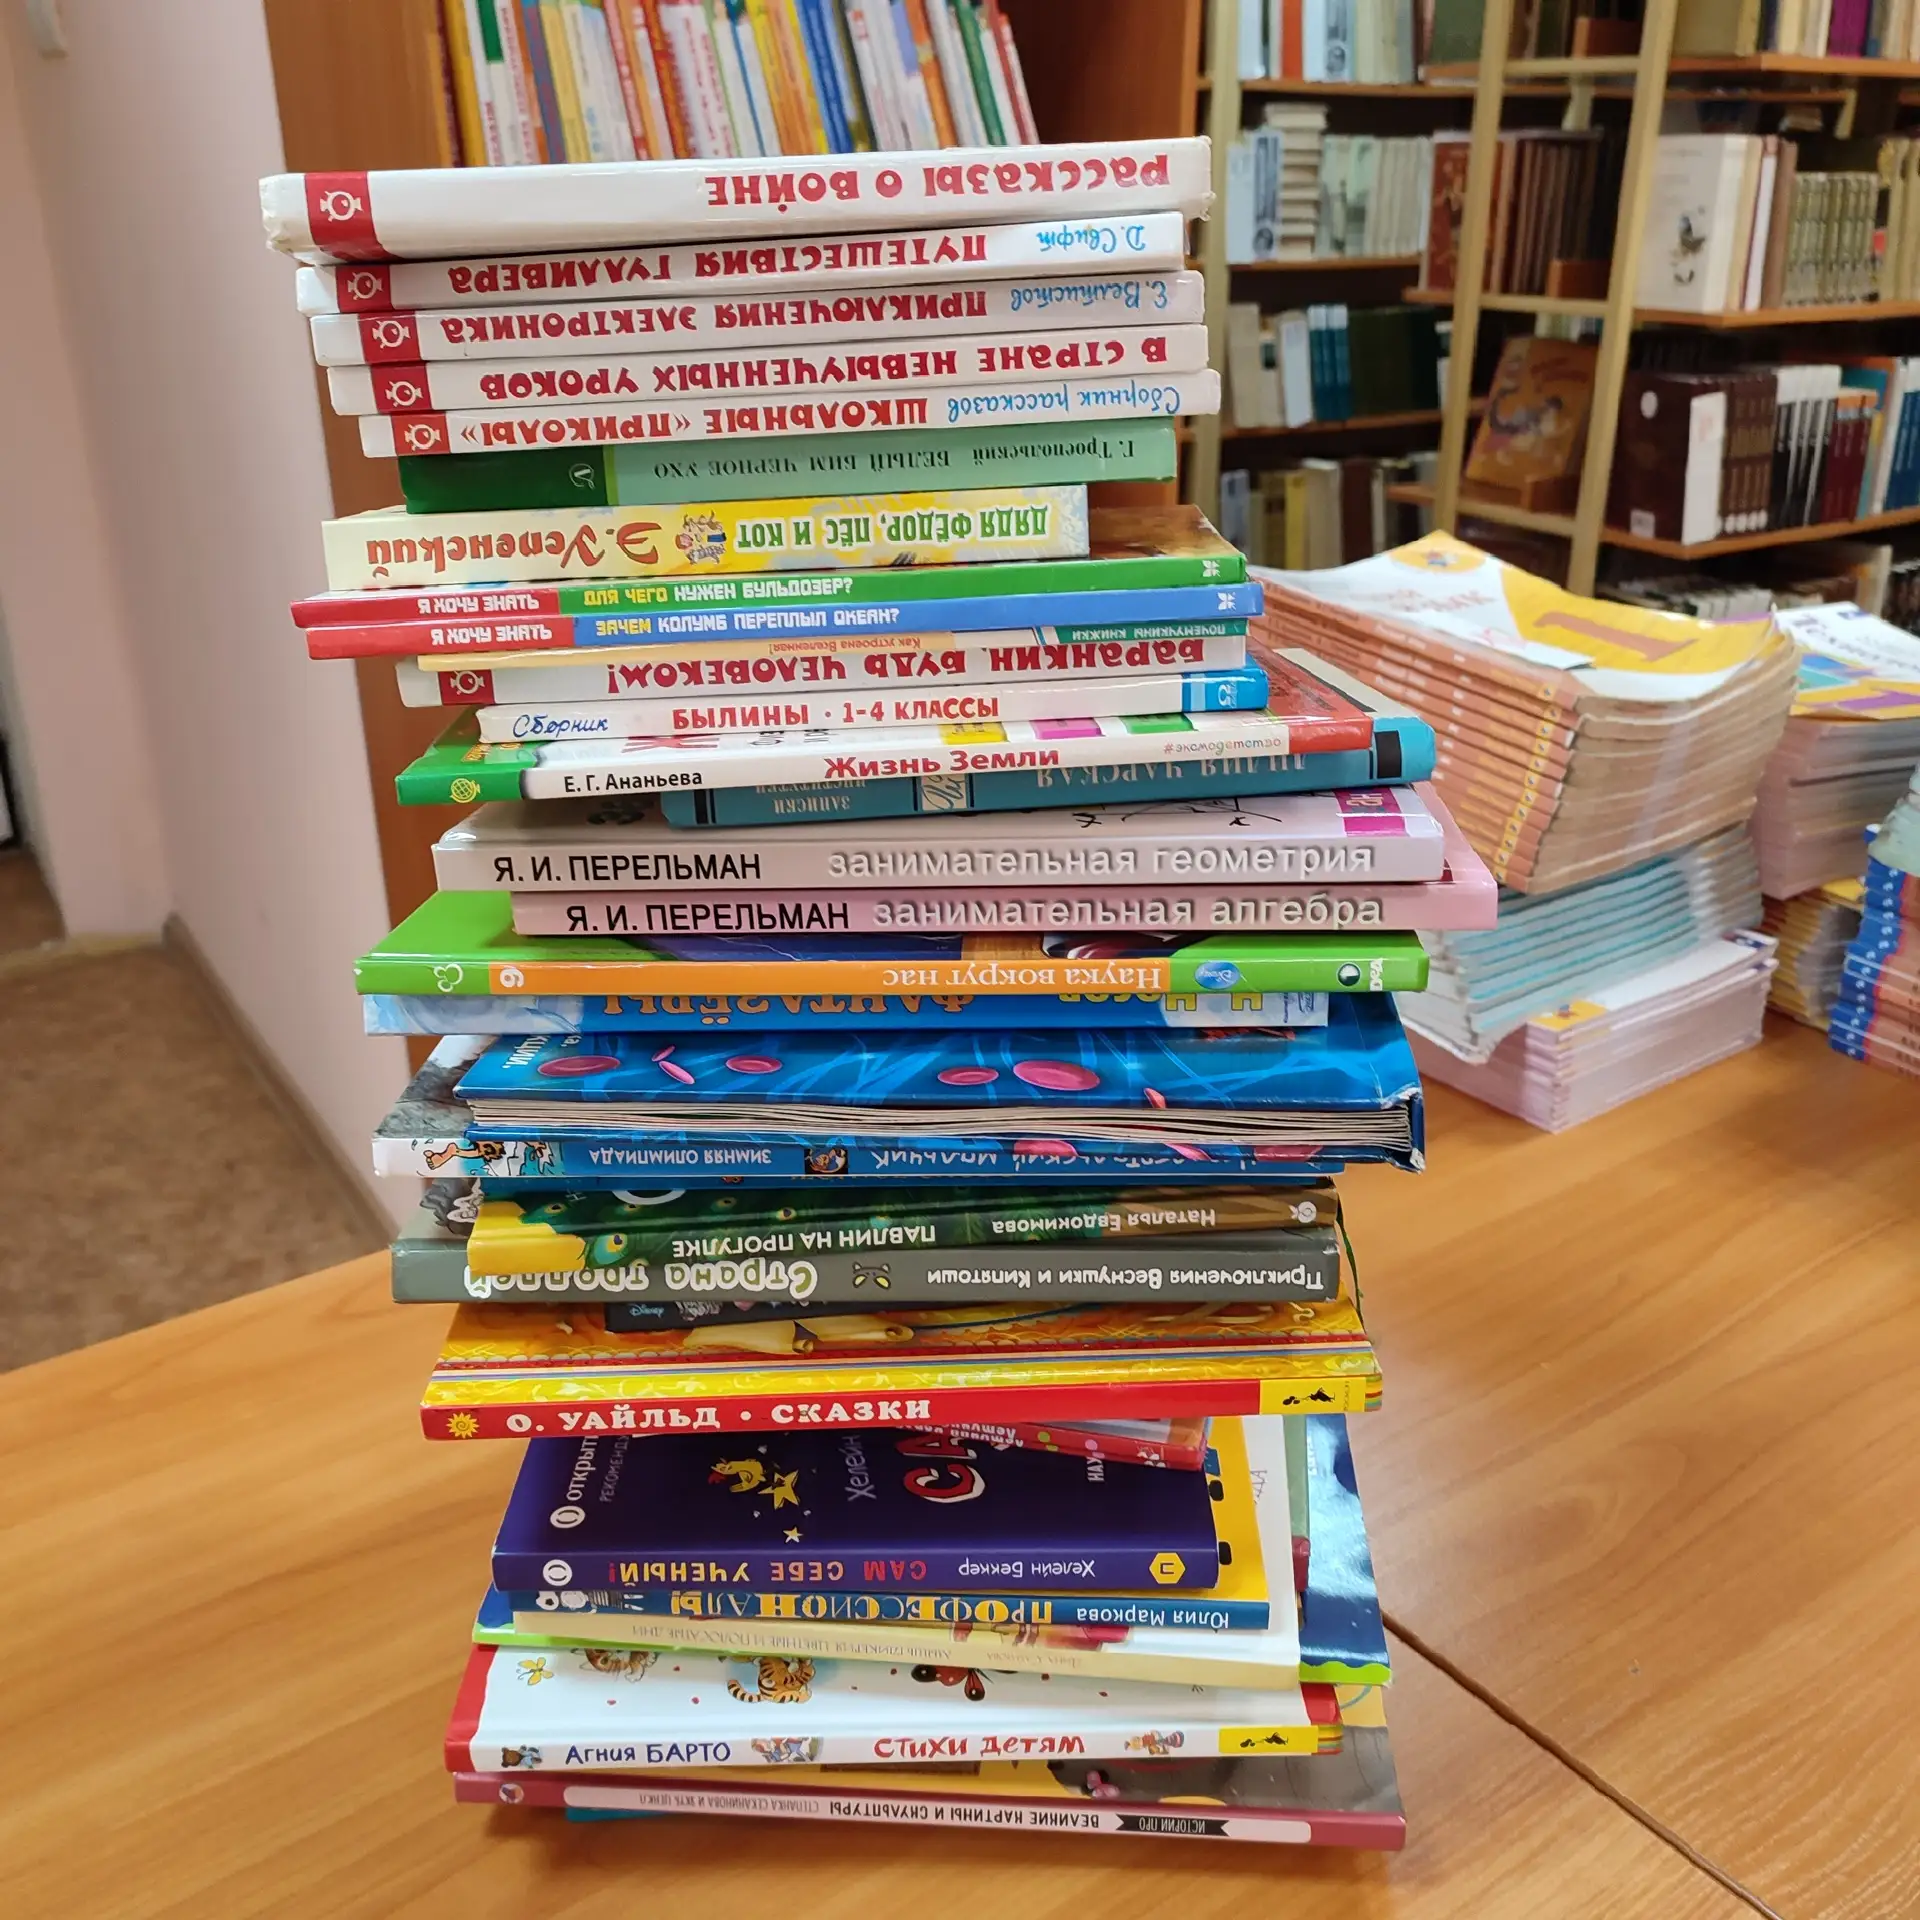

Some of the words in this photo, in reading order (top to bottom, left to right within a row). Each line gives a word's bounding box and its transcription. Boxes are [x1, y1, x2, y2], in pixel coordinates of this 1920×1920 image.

[704, 169, 858, 212] ВОЙНЕ
[1036, 225, 1118, 253] Свифт
[695, 234, 987, 278] ПУТЕШЕСТВИЯ
[715, 291, 987, 328] ПРИКЛЮЧЕНИЯ
[1142, 337, 1168, 361] В
[653, 350, 957, 393] НЕВЫУЧЕННЫХ
[480, 368, 639, 400] УРОКОВ
[948, 383, 1069, 422] рассказов
[1080, 380, 1180, 413] Сборник
[704, 398, 928, 434] ШКОЛЬНЫЕ
[461, 412, 691, 446] «ПРИКОЛЫ»
[655, 463, 699, 478] УХО
[811, 453, 857, 473] БИМ
[868, 450, 950, 474] БЕЛЫЙ
[826, 516, 870, 546] ПЁС
[880, 511, 972, 547] ФЁДОР,
[981, 505, 1049, 537] ДЯДЯ
[738, 522, 784, 549] КОТ
[795, 522, 811, 545] И
[367, 524, 605, 578] Успенский
[584, 590, 618, 606] ДЛЯ
[625, 587, 667, 603] ЧЕГО
[675, 583, 736, 601] НУЖЕН
[742, 578, 853, 599] БУЛЬДОЗЕР?
[418, 601, 430, 613] Я
[434, 597, 478, 614] ХОЧУ
[483, 595, 539, 611] ЗНАТЬ
[596, 619, 651, 636] ЗАЧЕМ
[658, 615, 726, 632] КОЛУМБ
[734, 609, 827, 630] ПЕРЕПЛЫЛ
[834, 607, 899, 626] ОКЕАН?
[431, 631, 443, 645] Я
[447, 627, 492, 644] ХОЧУ
[496, 624, 552, 641] ЗНАТЬ
[1072, 628, 1126, 641] КНИЖКИ
[607, 655, 846, 694] ЧЕЛОВЕКОМ!
[865, 650, 966, 679] БУДЬ
[673, 704, 808, 730] БЫЛИНЫ
[843, 701, 885, 723] 1-4
[895, 697, 998, 720] КЛАССЫ
[514, 714, 608, 738] Сборник
[825, 757, 941, 778] Жизнь
[949, 750, 1059, 772] Земли
[564, 777, 582, 793] Е.
[586, 775, 601, 791] Г.
[605, 772, 703, 790] Ананьева
[494, 858, 523, 881] Я.
[533, 857, 560, 881] И.
[570, 854, 761, 880] ПЕРЕЛЬМАН
[828, 852, 1135, 878] занимательная
[1153, 847, 1375, 879] геометрия
[567, 907, 597, 931] Я.
[607, 906, 638, 930] И.
[647, 903, 848, 930] ПЕРЕЛЬМАН
[873, 899, 1194, 927] занимательная
[1211, 893, 1383, 928] алгебра
[882, 969, 937, 986] нас
[946, 966, 1055, 989] вокруг
[1064, 967, 1160, 990] Наука
[589, 1148, 698, 1165] ОЛИМПИАДА
[704, 1148, 772, 1164] ЗИМНЯЯ
[992, 1213, 1120, 1234] Евдокимова
[1128, 1209, 1216, 1229] Наталья
[805, 1232, 832, 1249] НА
[837, 1223, 936, 1247] ПАВЛИН
[673, 1238, 794, 1258] ПРОГУЛКЕ
[665, 1257, 818, 1299] Страна
[927, 1270, 1031, 1288] Кипятоши
[1039, 1271, 1051, 1283] и
[1059, 1263, 1162, 1288] Веснушки
[1170, 1265, 1324, 1290] Приключения
[507, 1413, 543, 1432] О.
[558, 1404, 720, 1430] УАЙЛЬД
[771, 1399, 931, 1424] СКАЗКИ
[608, 1561, 751, 1587] УЧЕНЫЙ!
[771, 1561, 843, 1581] СЕБЕ
[864, 1560, 927, 1580] САМ
[958, 1558, 1023, 1577] Беккер
[1032, 1559, 1095, 1577] Хелейн
[670, 1592, 1052, 1625] ПРОФЕССИОНАЛЫ
[1077, 1607, 1164, 1626] Маркова
[1174, 1606, 1229, 1627] Юлия
[565, 1744, 635, 1765] Агния
[646, 1742, 731, 1763] БАРТО
[829, 1801, 931, 1820] СКУЛЬПТУРЫ
[937, 1808, 945, 1820] И
[949, 1808, 1022, 1825] КАРТИНЫ
[1029, 1812, 1099, 1828] ВЕЛИКИЕ
[1138, 1818, 1158, 1831] ПРО
[1161, 1818, 1206, 1834] ИСТОРИИ
